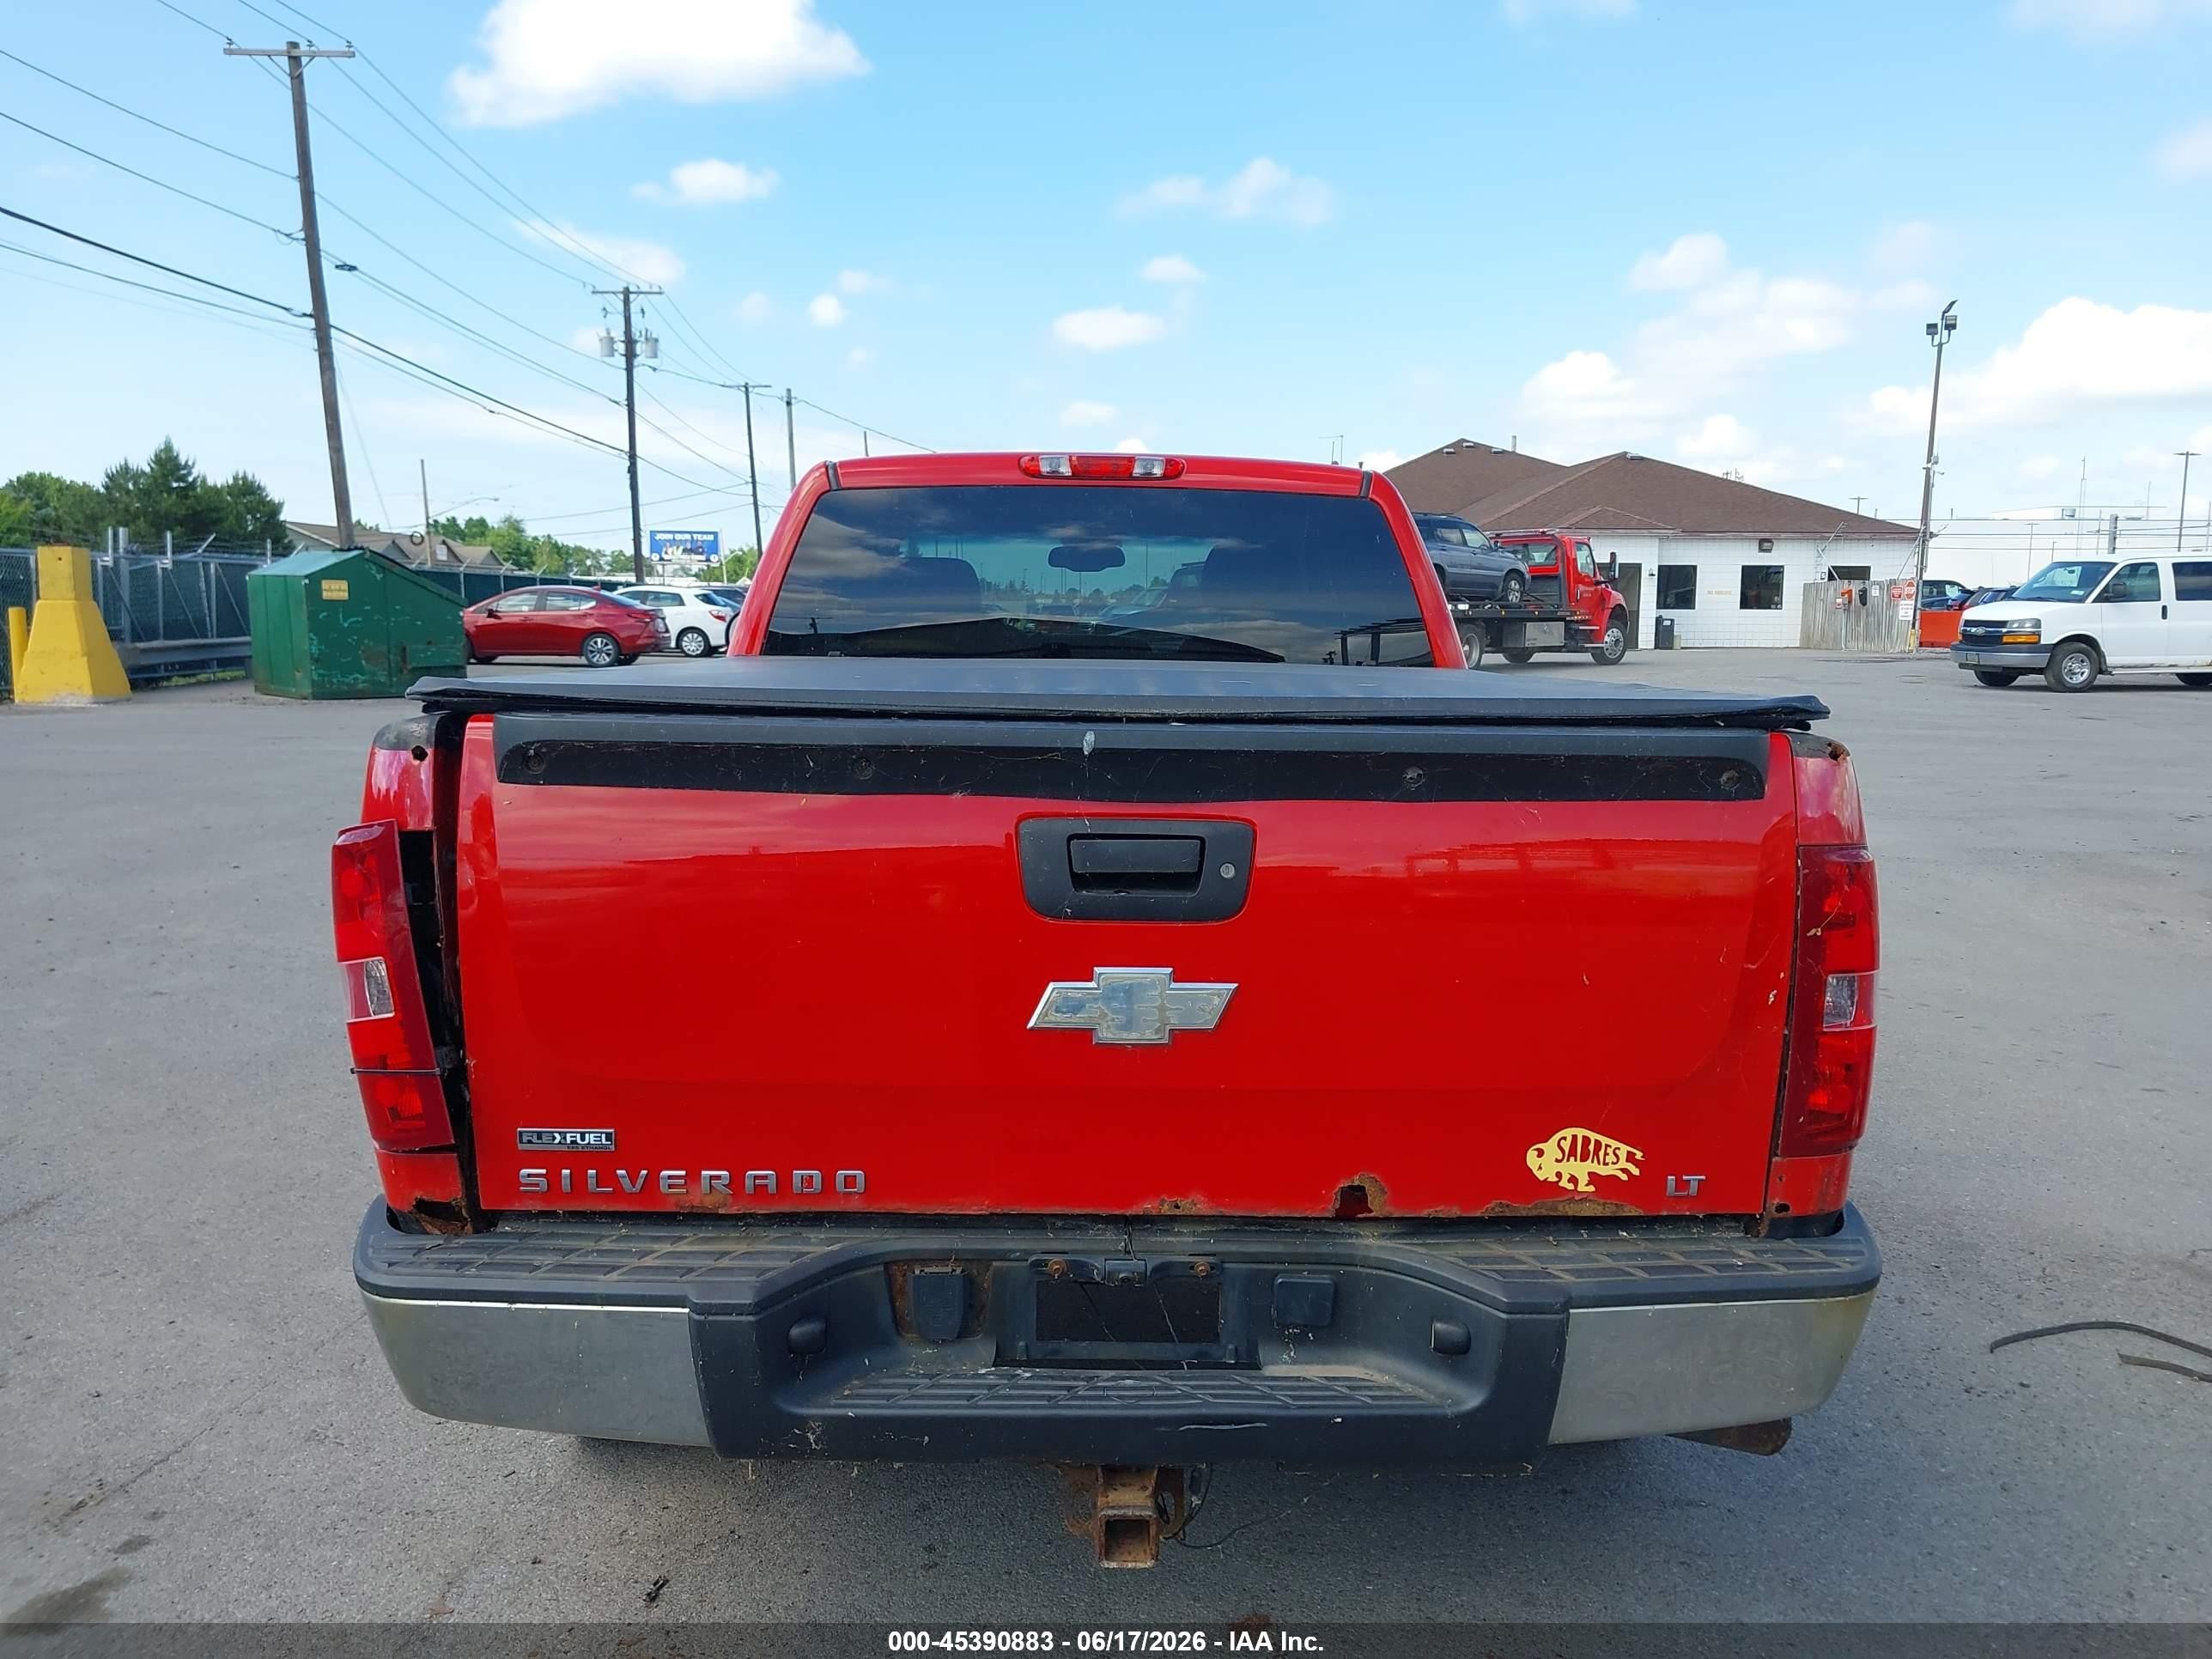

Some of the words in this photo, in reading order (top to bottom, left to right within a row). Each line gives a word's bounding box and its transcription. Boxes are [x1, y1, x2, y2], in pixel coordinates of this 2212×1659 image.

[1554, 1133, 1621, 1167] SABRES
[519, 1168, 866, 1195] SILVERADO
[1666, 1175, 1706, 1197] LT
